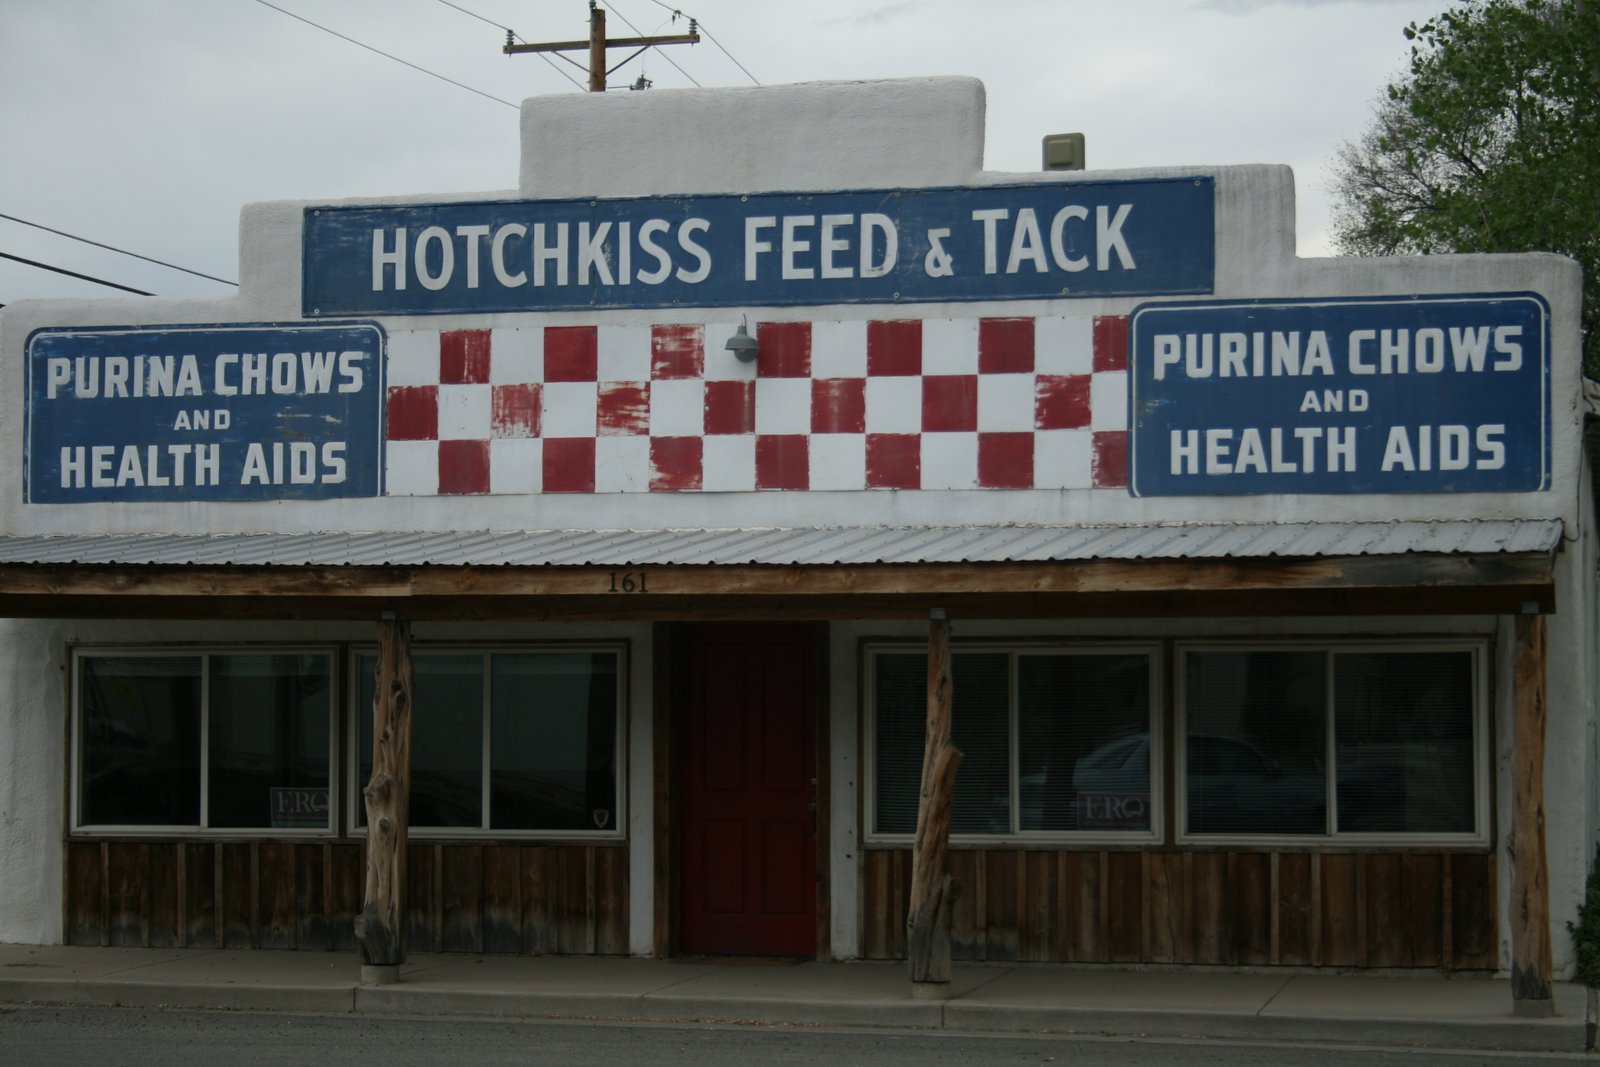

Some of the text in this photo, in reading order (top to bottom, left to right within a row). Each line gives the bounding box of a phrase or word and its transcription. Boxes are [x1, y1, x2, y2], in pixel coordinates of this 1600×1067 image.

[373, 205, 1136, 291] HOTCHKISS FEED & TACK
[47, 351, 364, 399] PURINA CHOWS
[1153, 325, 1523, 380] PURINA CHOWS
[173, 409, 231, 431] AND
[1300, 389, 1369, 412] AND
[61, 441, 346, 488] HEALTH AIDS
[1170, 424, 1506, 475] HEALTH AIDS
[608, 572, 648, 593] 161
